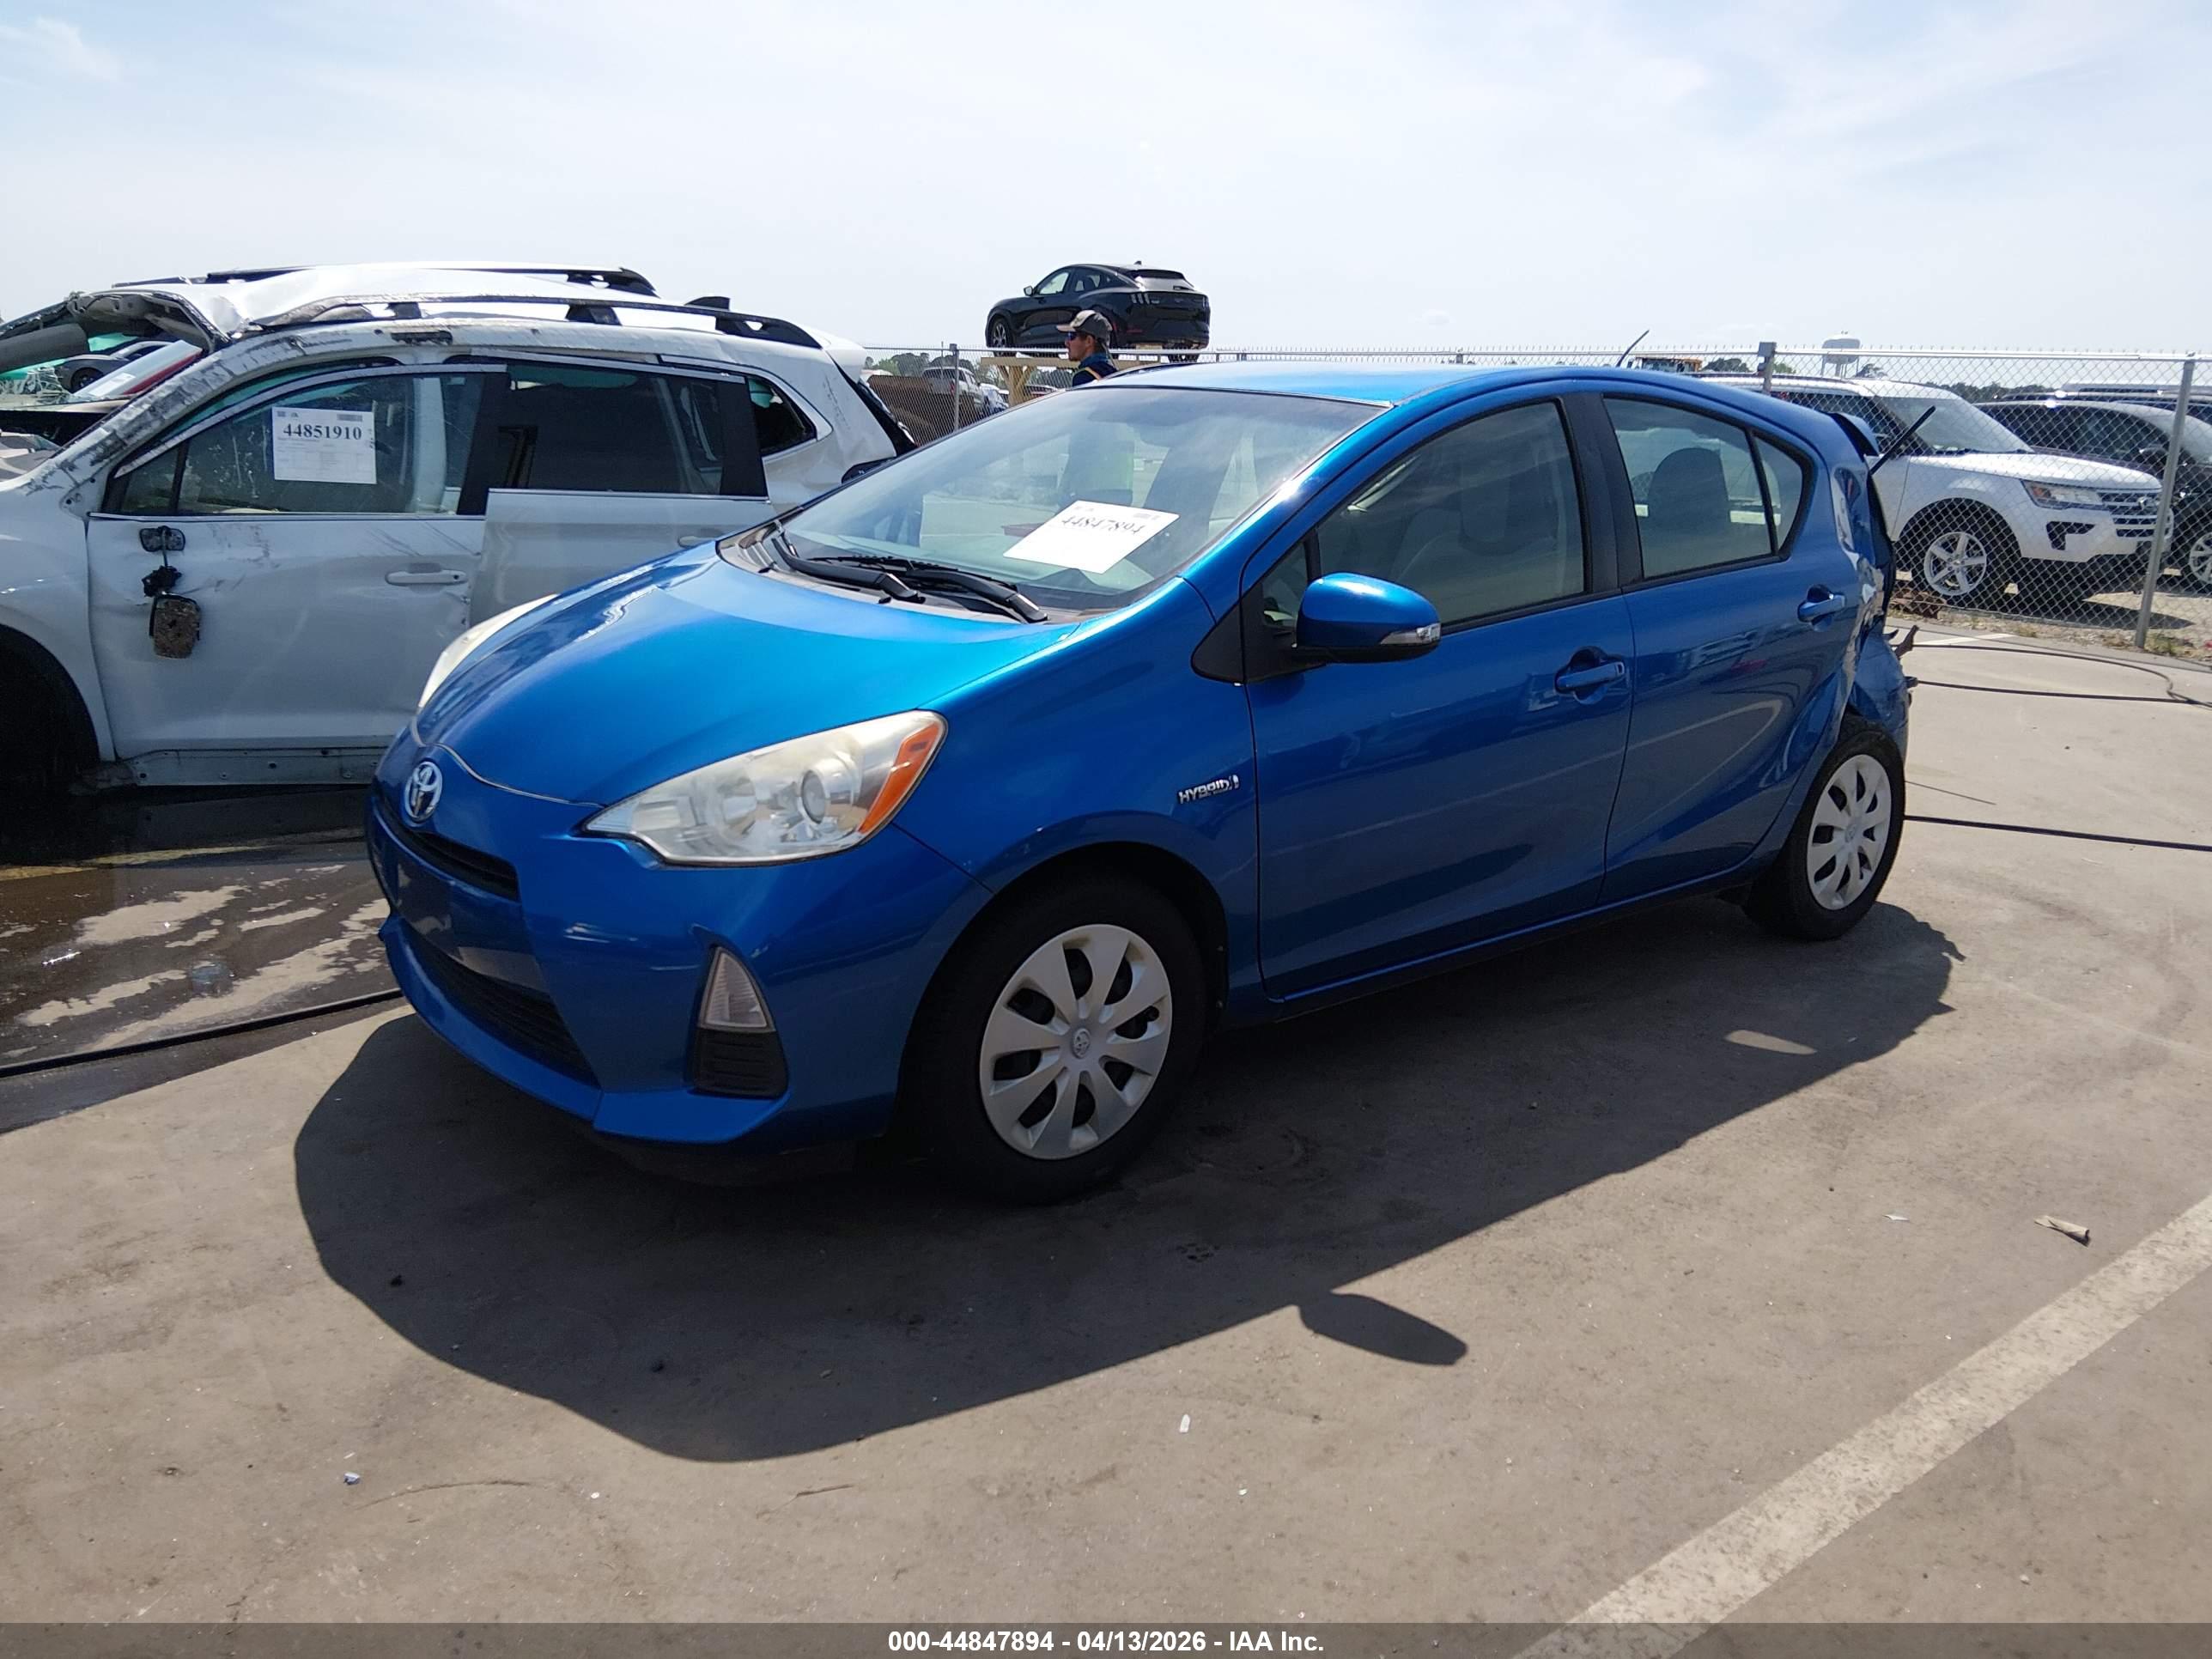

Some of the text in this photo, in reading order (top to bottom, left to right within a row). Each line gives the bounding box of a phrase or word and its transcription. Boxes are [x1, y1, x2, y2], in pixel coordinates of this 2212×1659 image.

[283, 423, 362, 441] 44851910
[1061, 515, 1146, 535] 44847894
[1178, 779, 1231, 804] HYBRID
